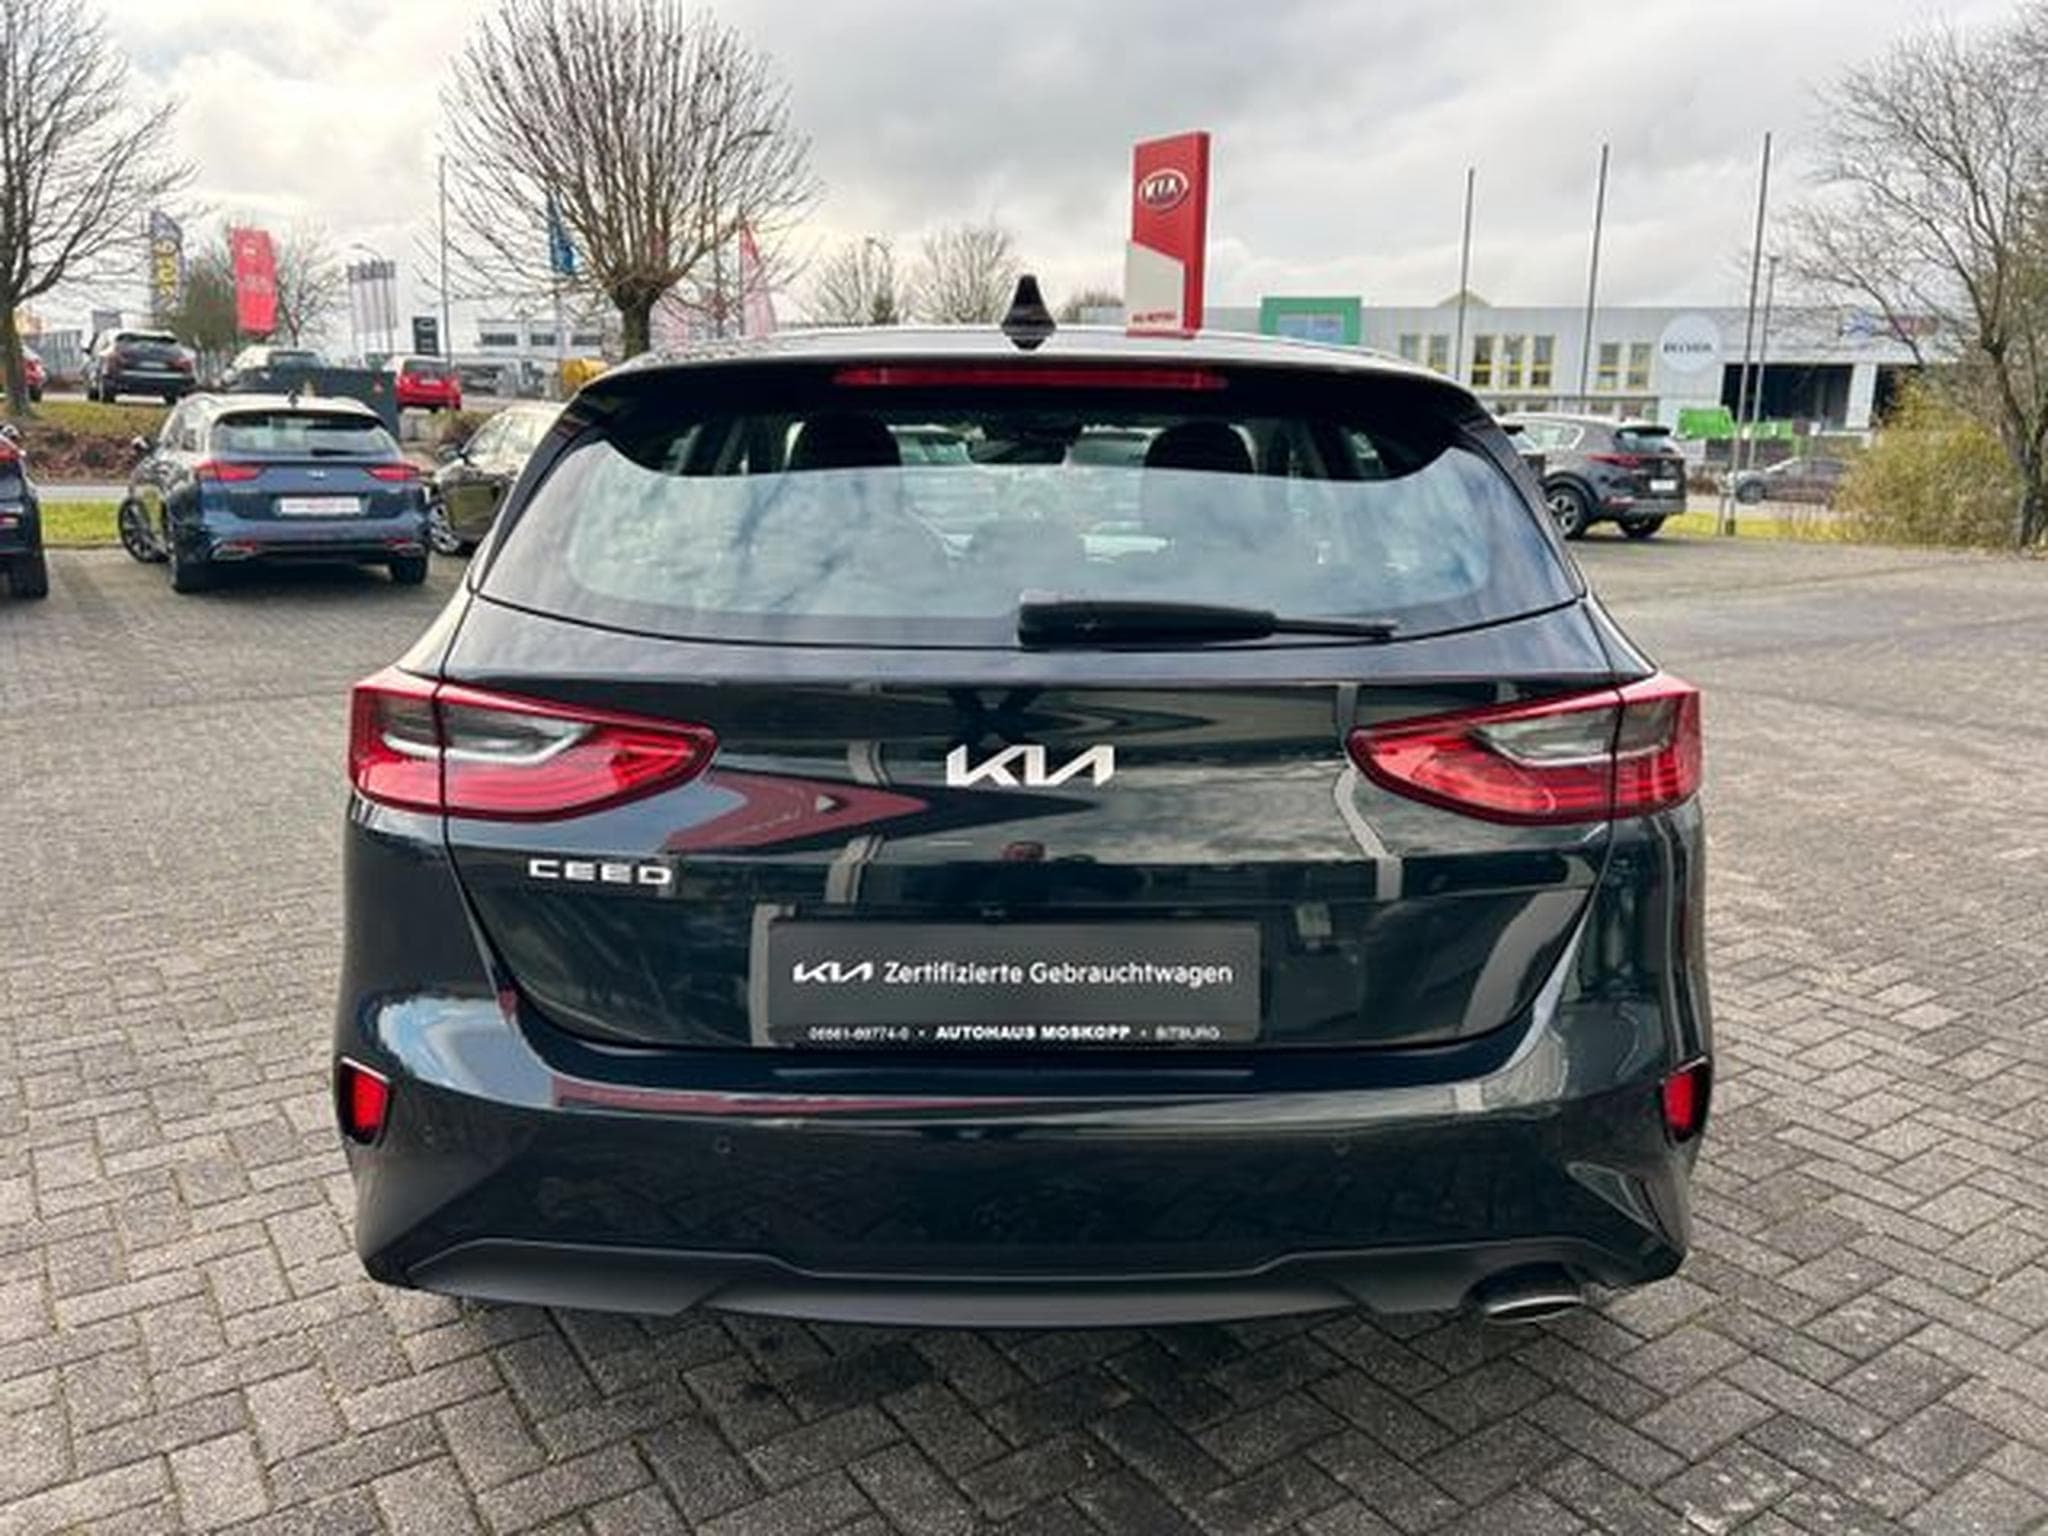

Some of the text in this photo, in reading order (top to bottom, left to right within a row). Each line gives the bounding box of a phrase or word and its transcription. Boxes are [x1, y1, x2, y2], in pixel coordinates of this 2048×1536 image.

[946, 744, 1115, 787] KIA
[529, 859, 672, 884] CEED
[792, 961, 1233, 988] KIA Zertifizierte Gebrauchtwagen
[934, 1025, 1036, 1041] AUTOHAUS
[1040, 1025, 1131, 1040] MOSKOPP
